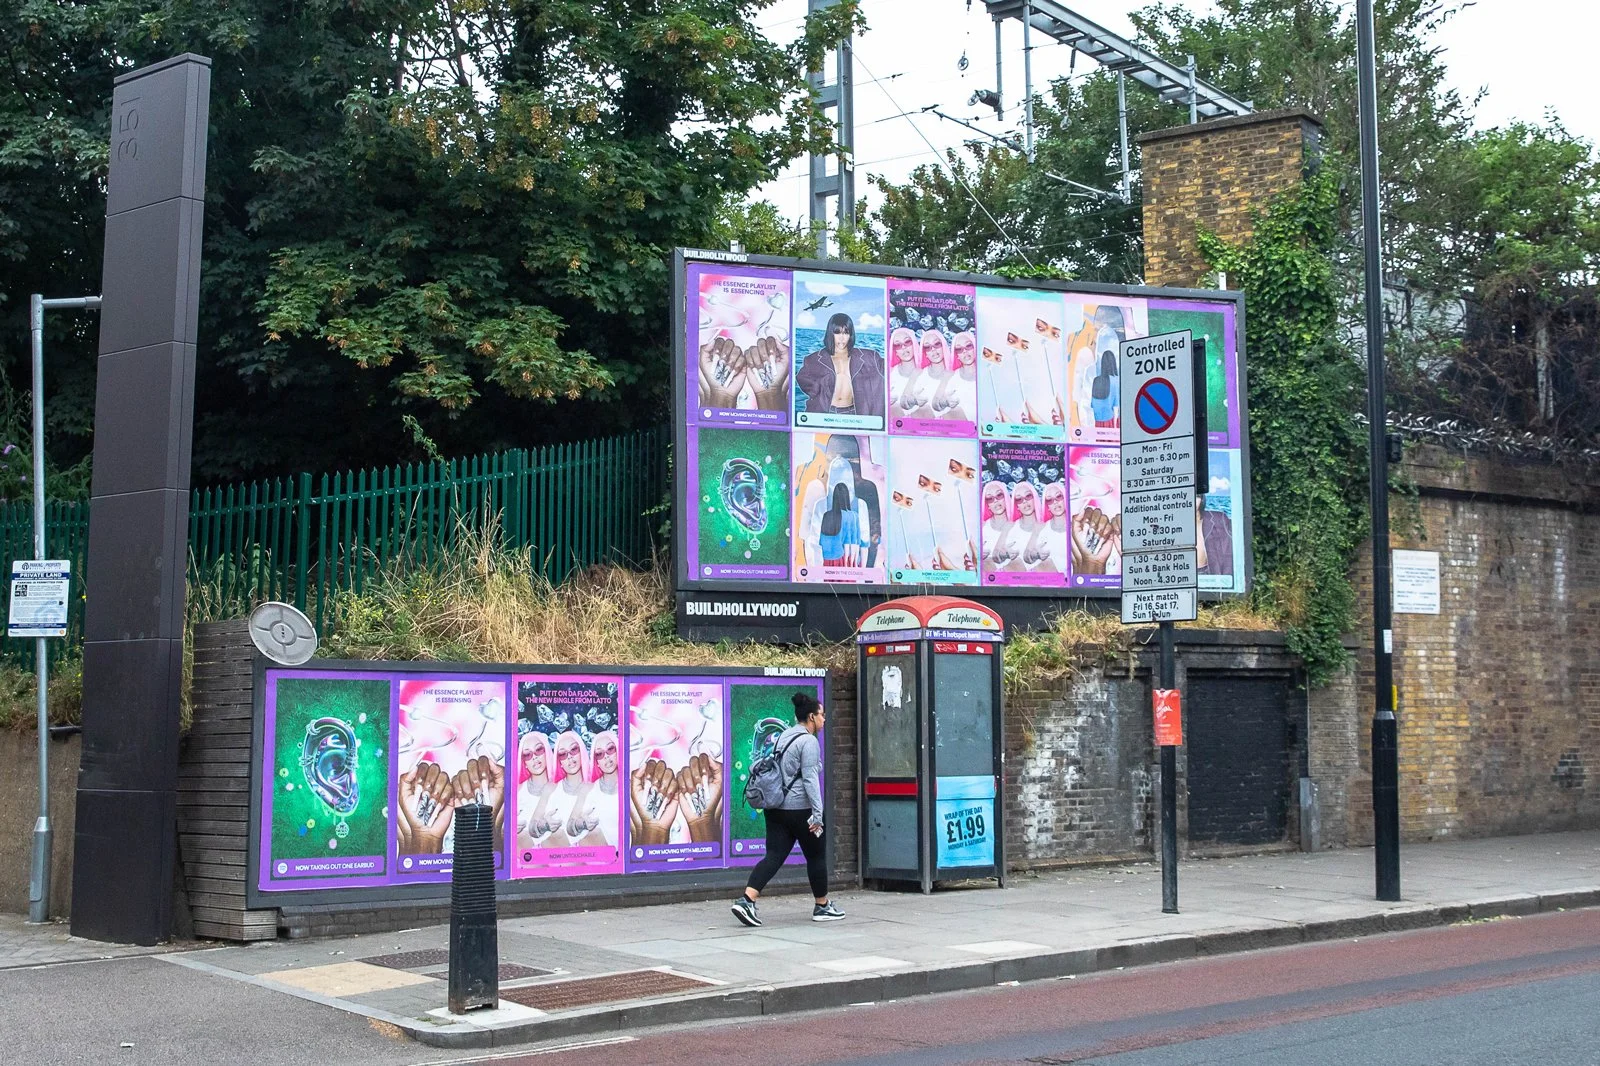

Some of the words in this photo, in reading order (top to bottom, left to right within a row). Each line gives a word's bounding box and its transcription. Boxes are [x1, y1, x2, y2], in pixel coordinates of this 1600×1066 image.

[118, 97, 142, 161] 351
[684, 249, 748, 262] BUILDHOLLYWOOD
[1127, 337, 1185, 357] Controlled
[1135, 356, 1176, 375] ZONE
[1142, 445, 1157, 453] Mon
[1163, 442, 1173, 451] Fri
[1126, 457, 1143, 466] 8.30
[1160, 452, 1177, 462] 6.30
[1142, 466, 1174, 476] Saturday
[1127, 479, 1144, 488] 8.30
[1161, 475, 1176, 485] 1.30
[1178, 476, 1189, 484] pm
[1129, 495, 1151, 504] Match
[1153, 494, 1170, 502] days
[1172, 491, 1187, 500] only
[1125, 503, 1160, 514] Additional
[1163, 501, 1192, 510] controls
[1143, 516, 1158, 524] Mon
[1164, 514, 1174, 522] Fri
[1130, 529, 1147, 537] 6.30
[1153, 526, 1170, 535] 8.30
[1172, 527, 1182, 535] pm
[1142, 538, 1175, 547] Saturday
[1133, 555, 1148, 563] 1.30
[1154, 554, 1172, 562] 4.30
[1173, 554, 1185, 562] pm
[1129, 566, 1143, 574] Sun
[1153, 564, 1170, 572] Bank
[1173, 563, 1189, 571] Hols
[1134, 578, 1152, 586] Noon
[1158, 576, 1176, 584] 4.30
[1136, 594, 1154, 602] Next
[1156, 593, 1179, 601] match
[686, 602, 797, 616] BUILDHOLLYWOOD
[1133, 603, 1143, 611] Fri
[1155, 602, 1167, 610] Sat
[948, 613, 981, 624] Telephone
[1132, 611, 1146, 619] Sun
[1158, 610, 1171, 618] Jun
[877, 615, 905, 626] Telephone
[947, 631, 967, 639] hotspot
[764, 667, 826, 677] BUILDHOLLYWOOD
[944, 812, 958, 820] WRAP
[964, 808, 973, 816] THE
[974, 806, 982, 814] DAY
[947, 814, 985, 843] £1.99
[948, 842, 964, 850] MONDAY
